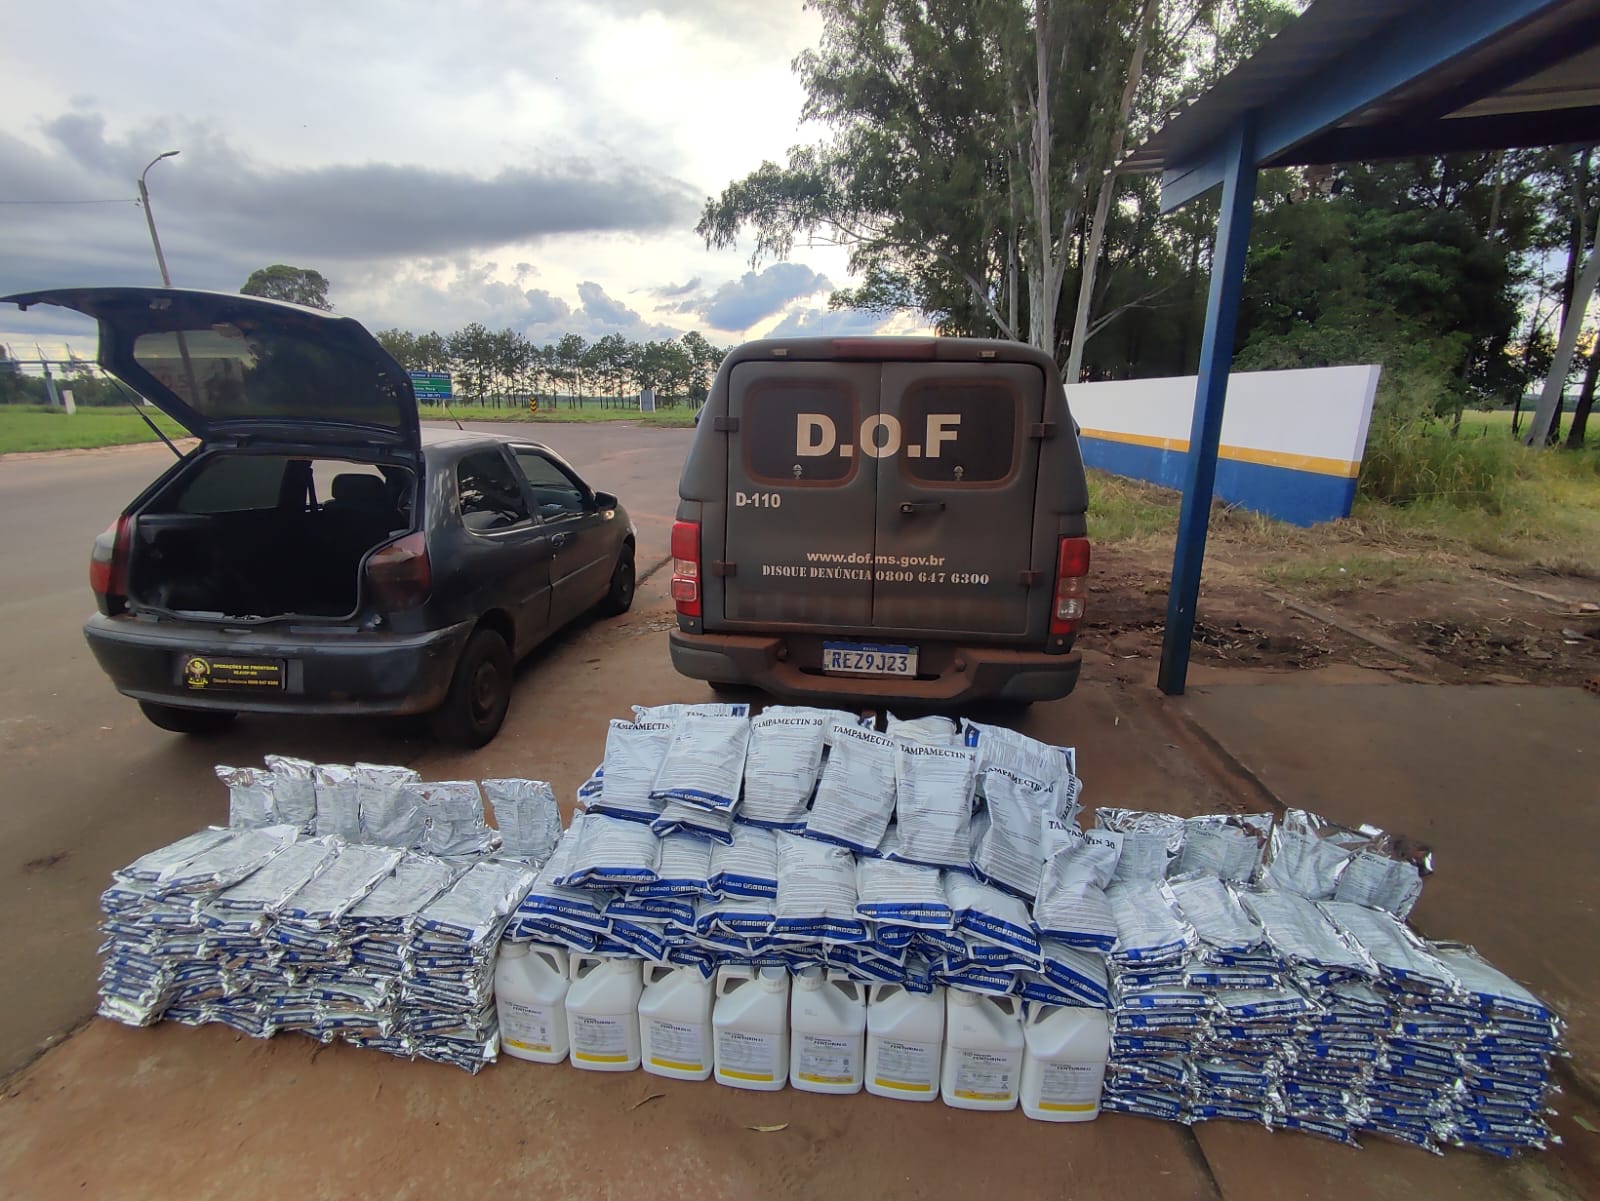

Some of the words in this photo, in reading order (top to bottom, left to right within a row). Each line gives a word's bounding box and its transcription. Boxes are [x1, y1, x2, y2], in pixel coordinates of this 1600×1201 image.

[796, 413, 962, 458] D.O.F
[735, 491, 781, 508] D-110
[806, 551, 946, 568] www.dof.ms.gov.br
[761, 564, 807, 578] DISQUE
[809, 565, 872, 581] DENÚNCIA
[875, 570, 914, 582] 0800
[918, 572, 947, 583] 647
[950, 572, 990, 585] 6300
[831, 651, 909, 672] REZ9J23
[812, 718, 823, 726] 30
[899, 744, 966, 759] TAMPAMECTIN
[1104, 839, 1116, 849] 30
